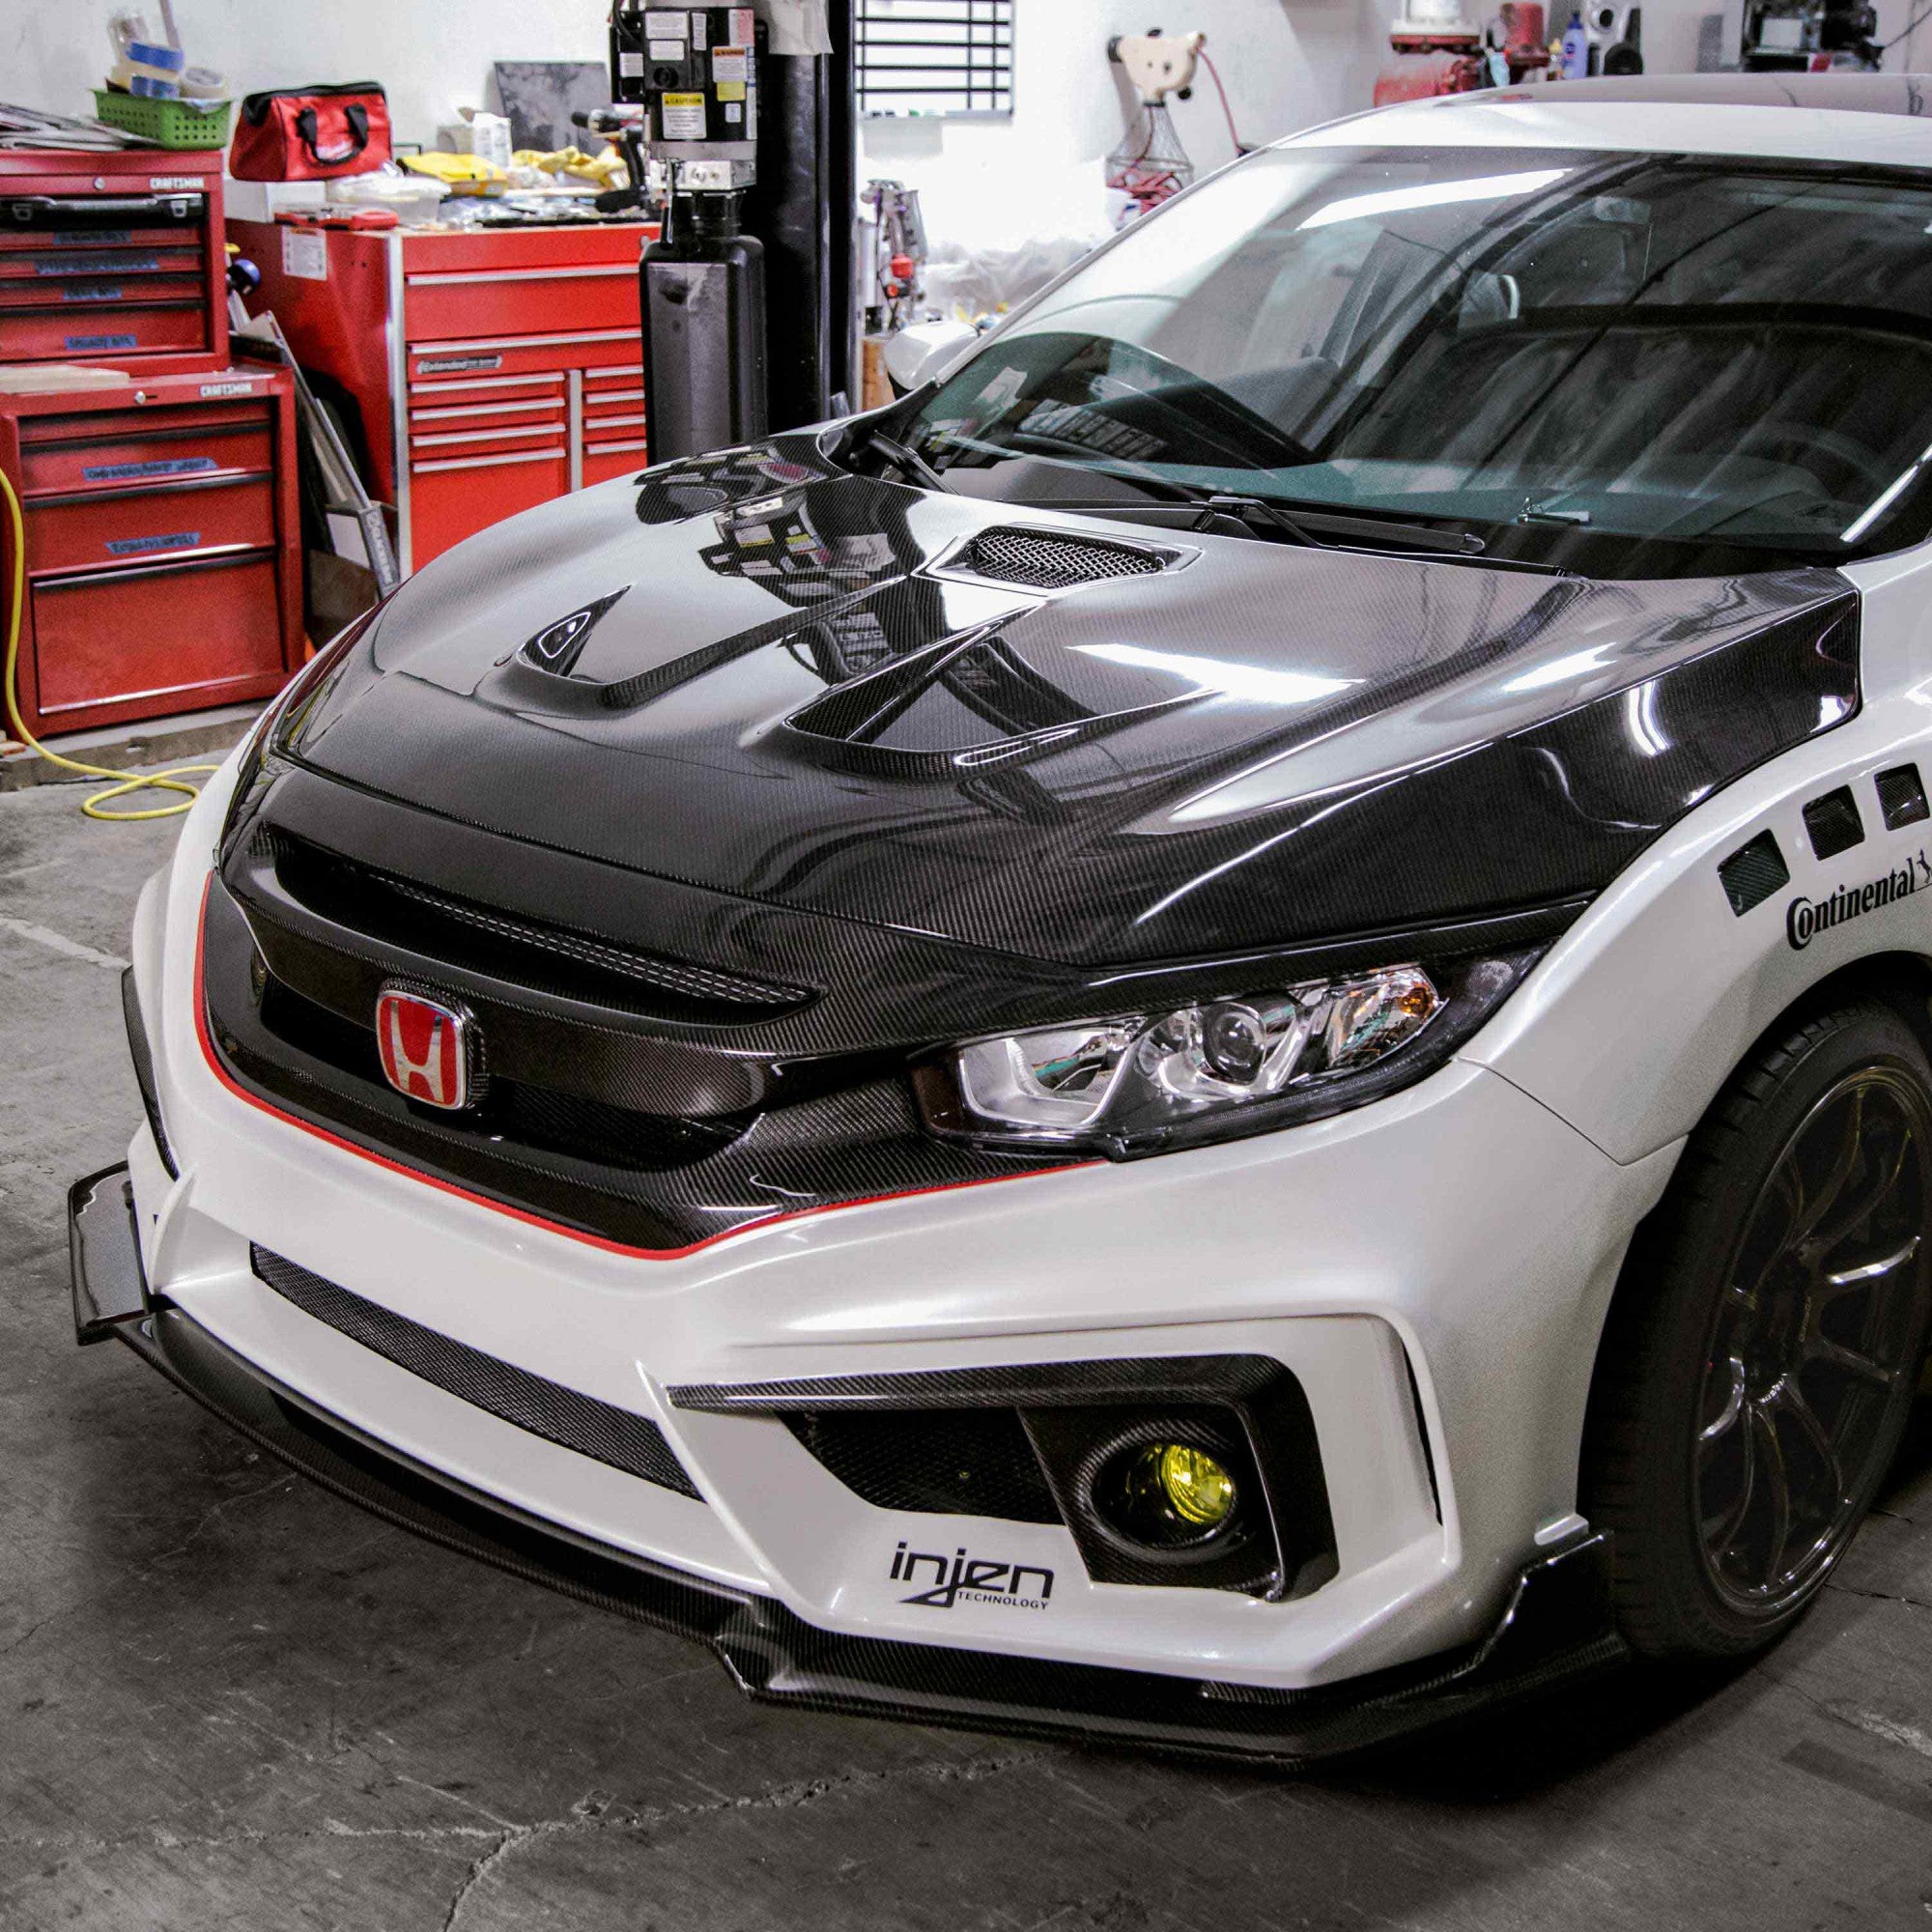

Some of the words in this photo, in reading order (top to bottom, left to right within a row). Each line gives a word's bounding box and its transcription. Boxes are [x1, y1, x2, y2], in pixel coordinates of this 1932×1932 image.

[1787, 857, 1916, 951] Continental
[890, 1541, 1055, 1608] injen
[957, 1590, 1050, 1610] TECHNOLOGY
